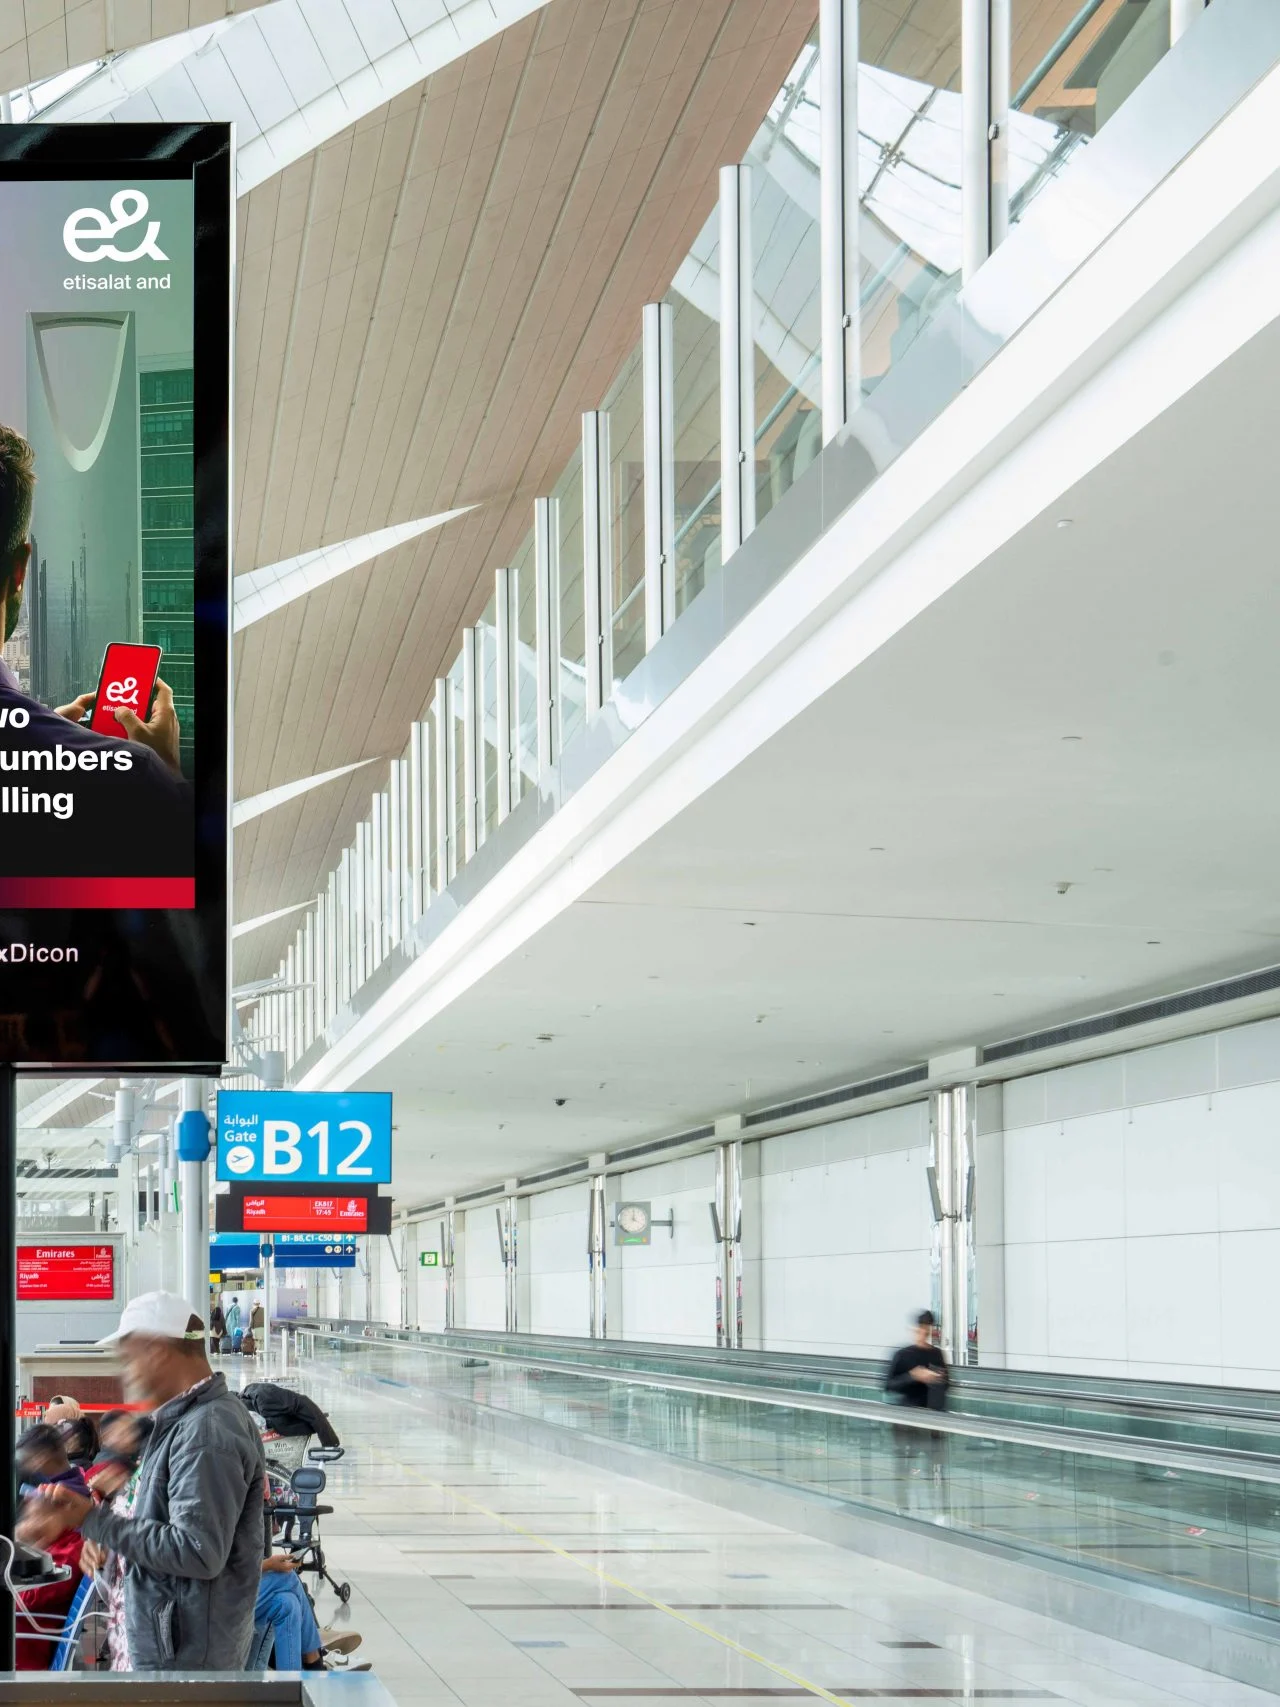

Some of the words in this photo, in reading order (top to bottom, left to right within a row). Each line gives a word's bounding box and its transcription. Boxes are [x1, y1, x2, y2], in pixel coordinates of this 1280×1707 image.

[63, 273, 132, 290] etisalat
[137, 273, 170, 290] and
[224, 1114, 258, 1126] البوابة
[224, 1130, 257, 1143] Gate
[263, 1120, 373, 1175] B12
[246, 1208, 266, 1216] Riyadh
[36, 1249, 75, 1259] Emirates
[19, 1273, 39, 1281] Riyadh
